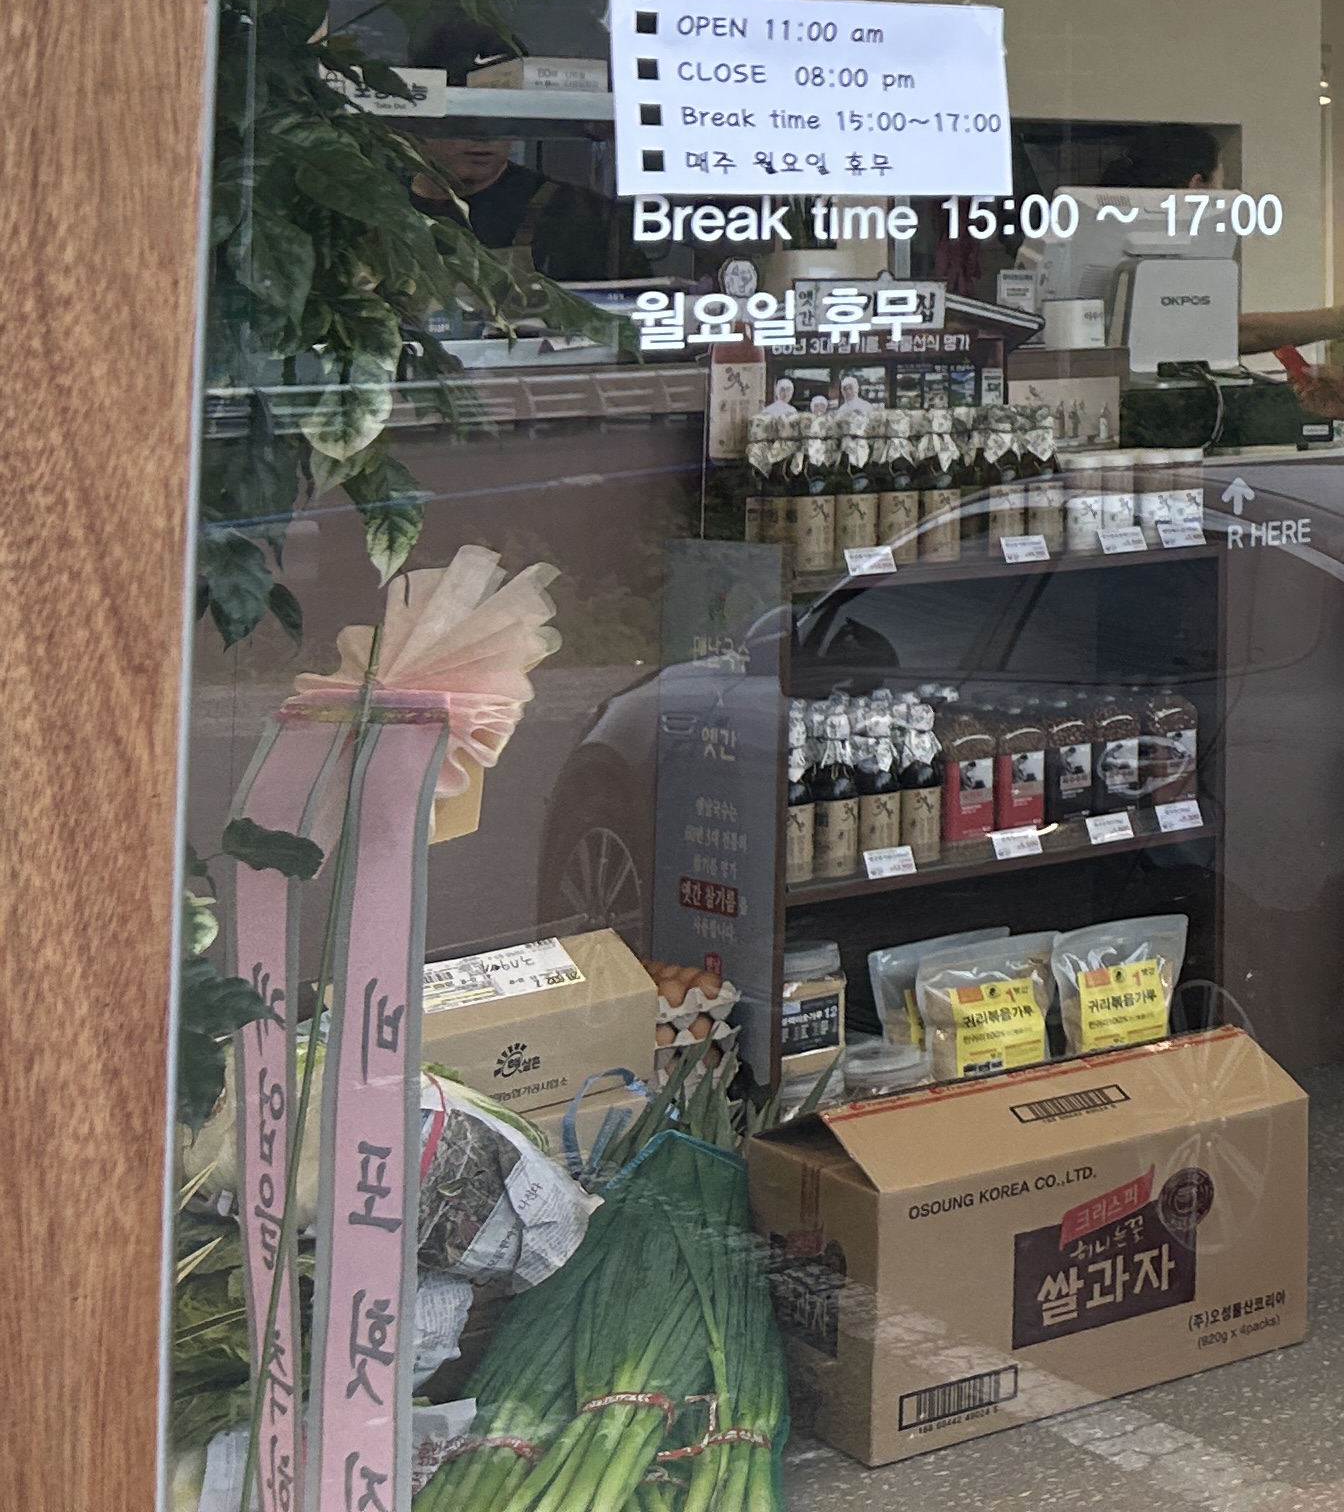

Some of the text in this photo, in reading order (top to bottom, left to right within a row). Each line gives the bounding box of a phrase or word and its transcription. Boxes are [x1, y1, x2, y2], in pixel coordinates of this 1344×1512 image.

[677, 15, 884, 44] OPEN 11:00 am
[677, 61, 915, 91] CLOSE 08:00 pm
[681, 106, 1002, 133] Break time 15:00~17:00
[686, 151, 893, 176] 매주 월요일 휴무
[633, 194, 792, 242] Break
[812, 196, 919, 241] time
[944, 193, 1079, 240] 15:00
[1161, 193, 1283, 237] 17:00
[1160, 294, 1212, 307] OKPOS
[632, 287, 923, 351] 월요일 휴무
[1249, 519, 1311, 548] HERE
[908, 1192, 975, 1221] OSOUNG
[979, 1180, 1031, 1205] KOREA
[1074, 1183, 1139, 1233] 크리스피
[1037, 1244, 1176, 1327] 쌀과자
